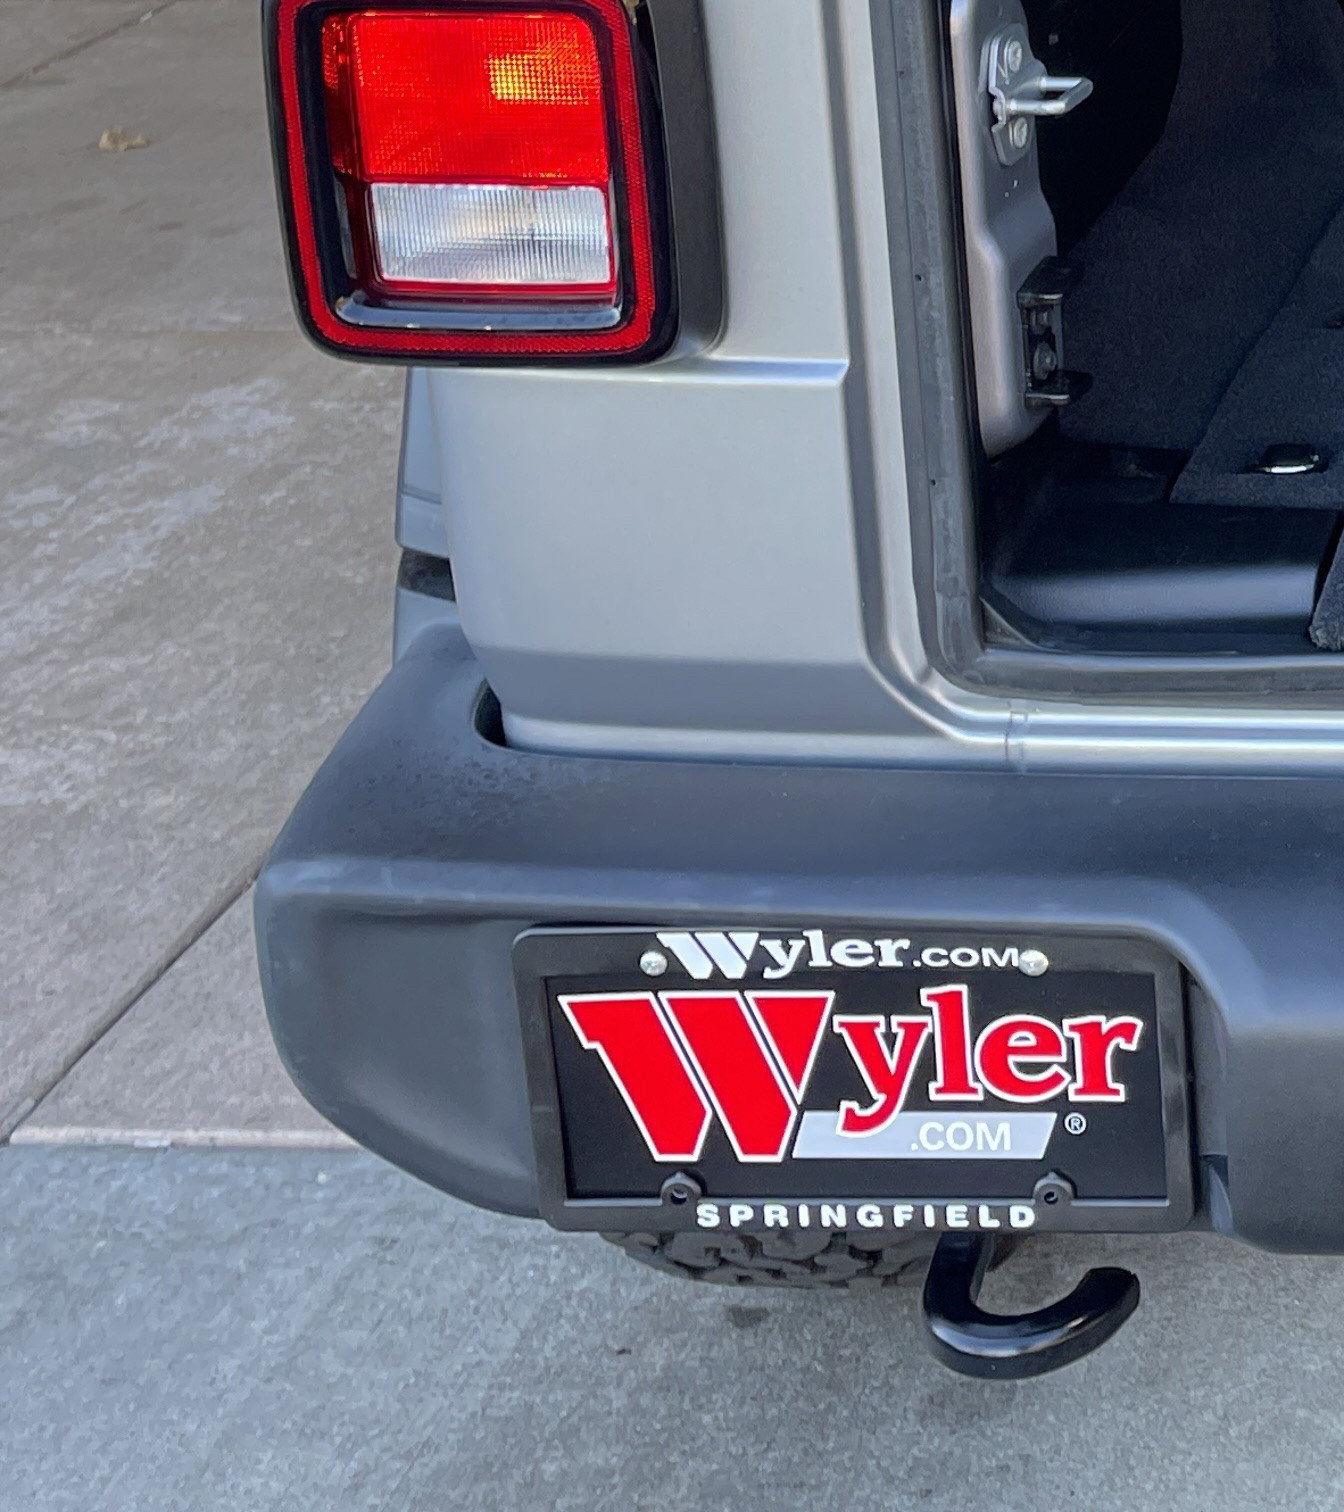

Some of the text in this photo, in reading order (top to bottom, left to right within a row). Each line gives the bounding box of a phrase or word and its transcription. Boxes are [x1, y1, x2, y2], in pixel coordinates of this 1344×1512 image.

[558, 984, 1144, 1163] Wyler
[909, 1122, 1012, 1152] .COM
[697, 1203, 1036, 1229] SPRINGFIELD
